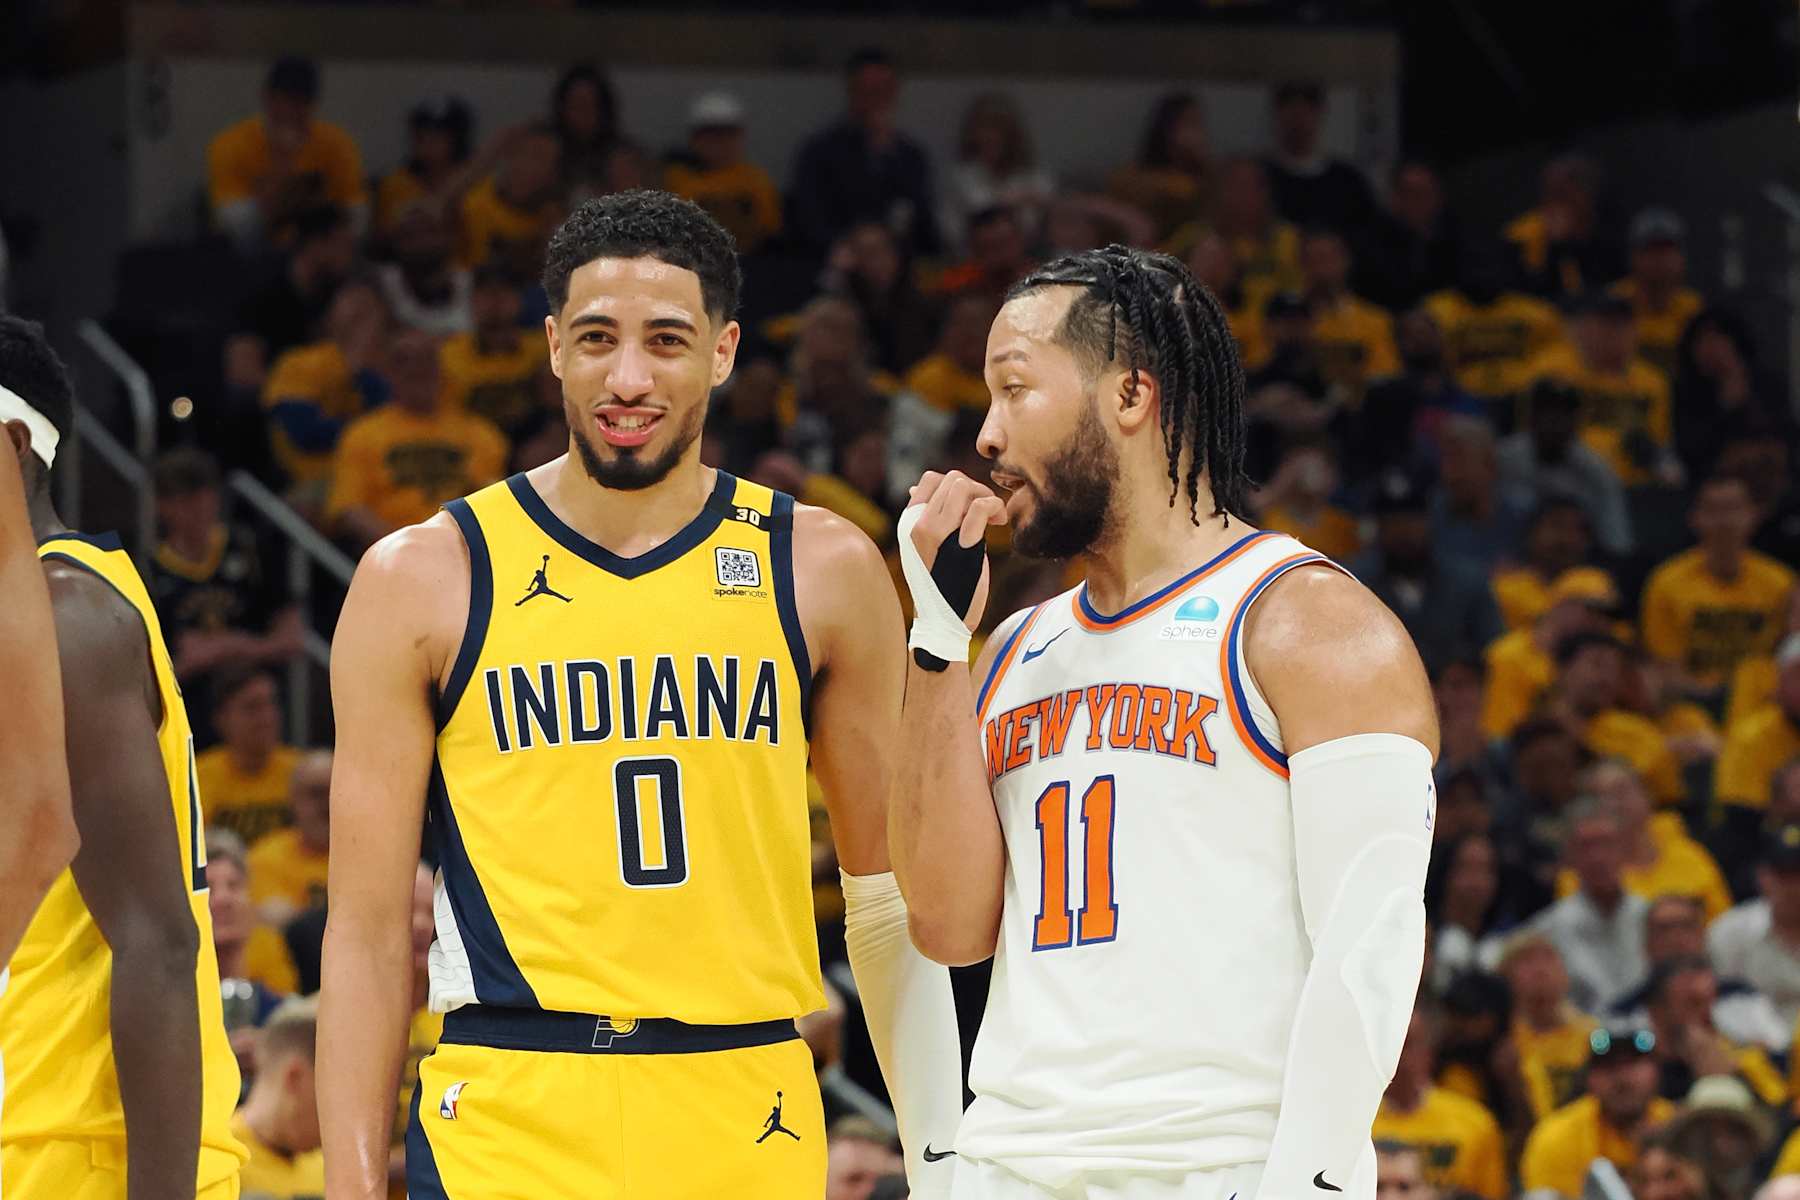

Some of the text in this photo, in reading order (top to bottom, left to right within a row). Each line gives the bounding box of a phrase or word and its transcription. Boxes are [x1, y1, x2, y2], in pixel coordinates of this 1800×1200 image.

[736, 508, 760, 526] 30
[713, 587, 768, 599] spokenote
[1161, 625, 1217, 640] sphere
[484, 654, 781, 754] INDIANA
[985, 683, 1220, 784] NEW YORK
[612, 755, 690, 889] 0
[1031, 774, 1119, 952] 11
